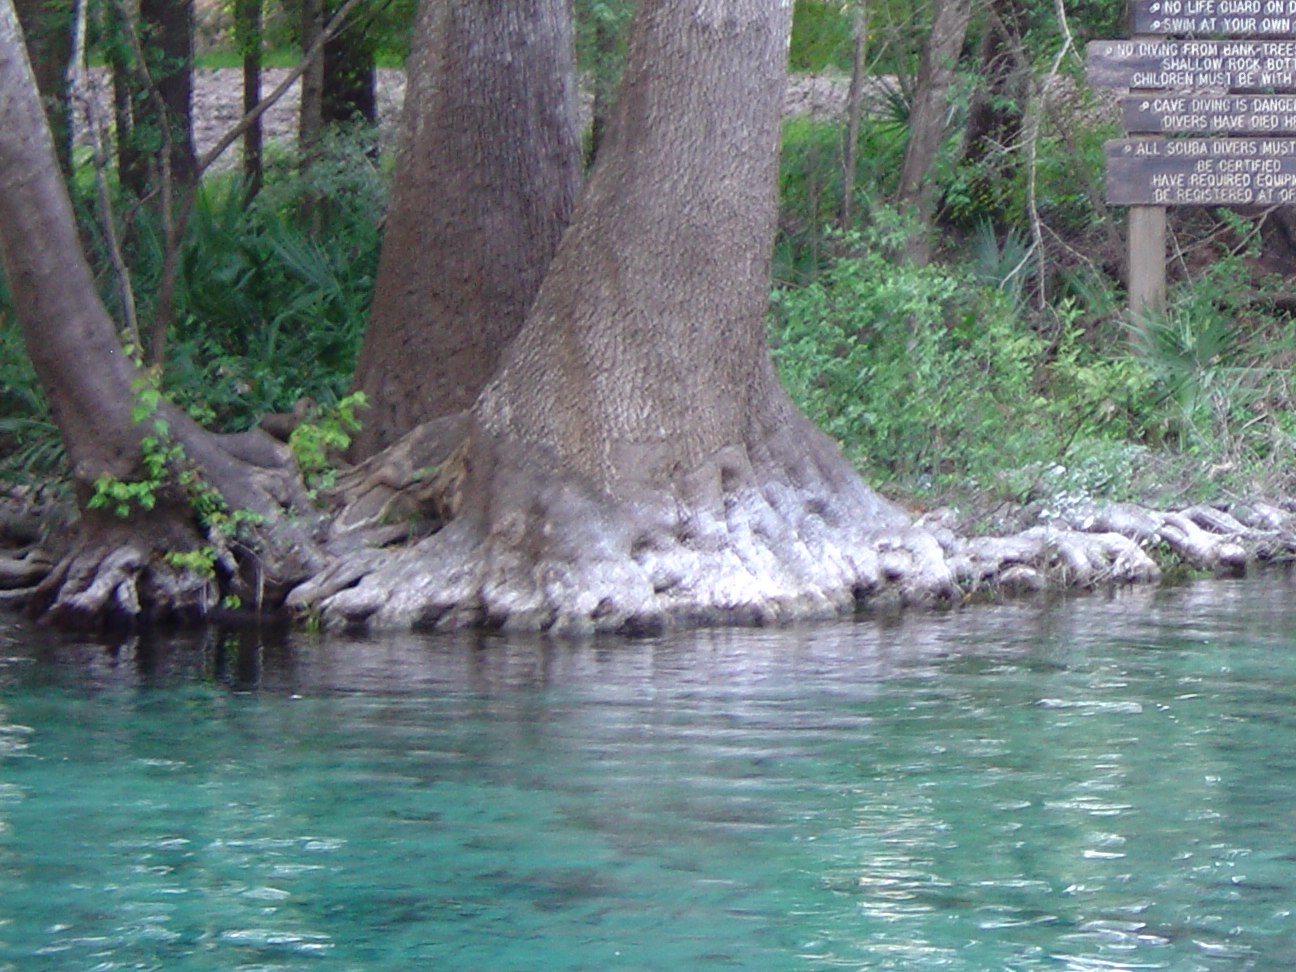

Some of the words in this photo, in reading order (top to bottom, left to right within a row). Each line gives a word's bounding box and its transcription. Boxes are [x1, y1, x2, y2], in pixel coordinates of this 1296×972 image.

[1164, 1, 1181, 13] NO
[1189, 1, 1214, 12] LIFE
[1220, 1, 1260, 13] GUARD
[1267, 1, 1284, 12] ON
[1163, 19, 1196, 30] SWIM
[1202, 19, 1216, 30] AT
[1224, 19, 1256, 30] YOUR
[1262, 19, 1290, 30] OWN
[1117, 43, 1133, 56] NO
[1139, 44, 1177, 56] DIVING
[1183, 43, 1218, 56] FROM
[1163, 59, 1222, 70] SHALLOW
[1228, 58, 1261, 70] ROCK
[1133, 73, 1193, 85] CHILDREN
[1199, 73, 1231, 85] MUST
[1239, 73, 1255, 85] BE
[1262, 73, 1291, 85] WITH
[1154, 100, 1186, 112] CAVE
[1192, 100, 1230, 112] DIVING
[1236, 100, 1247, 112] IS
[1164, 116, 1207, 128] DIVERS
[1213, 116, 1244, 127] HAVE
[1251, 116, 1278, 127] DIED
[1137, 143, 1160, 154] ALL
[1166, 142, 1207, 155] SCUBA
[1213, 142, 1256, 155] DIVERS
[1262, 141, 1296, 154] MUST
[1197, 160, 1213, 172] BE
[1219, 160, 1281, 172] CERTIFIED
[1152, 174, 1184, 186] HAVE
[1190, 174, 1250, 186] REQUIRED
[1155, 189, 1171, 201] BE
[1177, 189, 1252, 201] REGISTERED
[1259, 188, 1275, 200] AT
